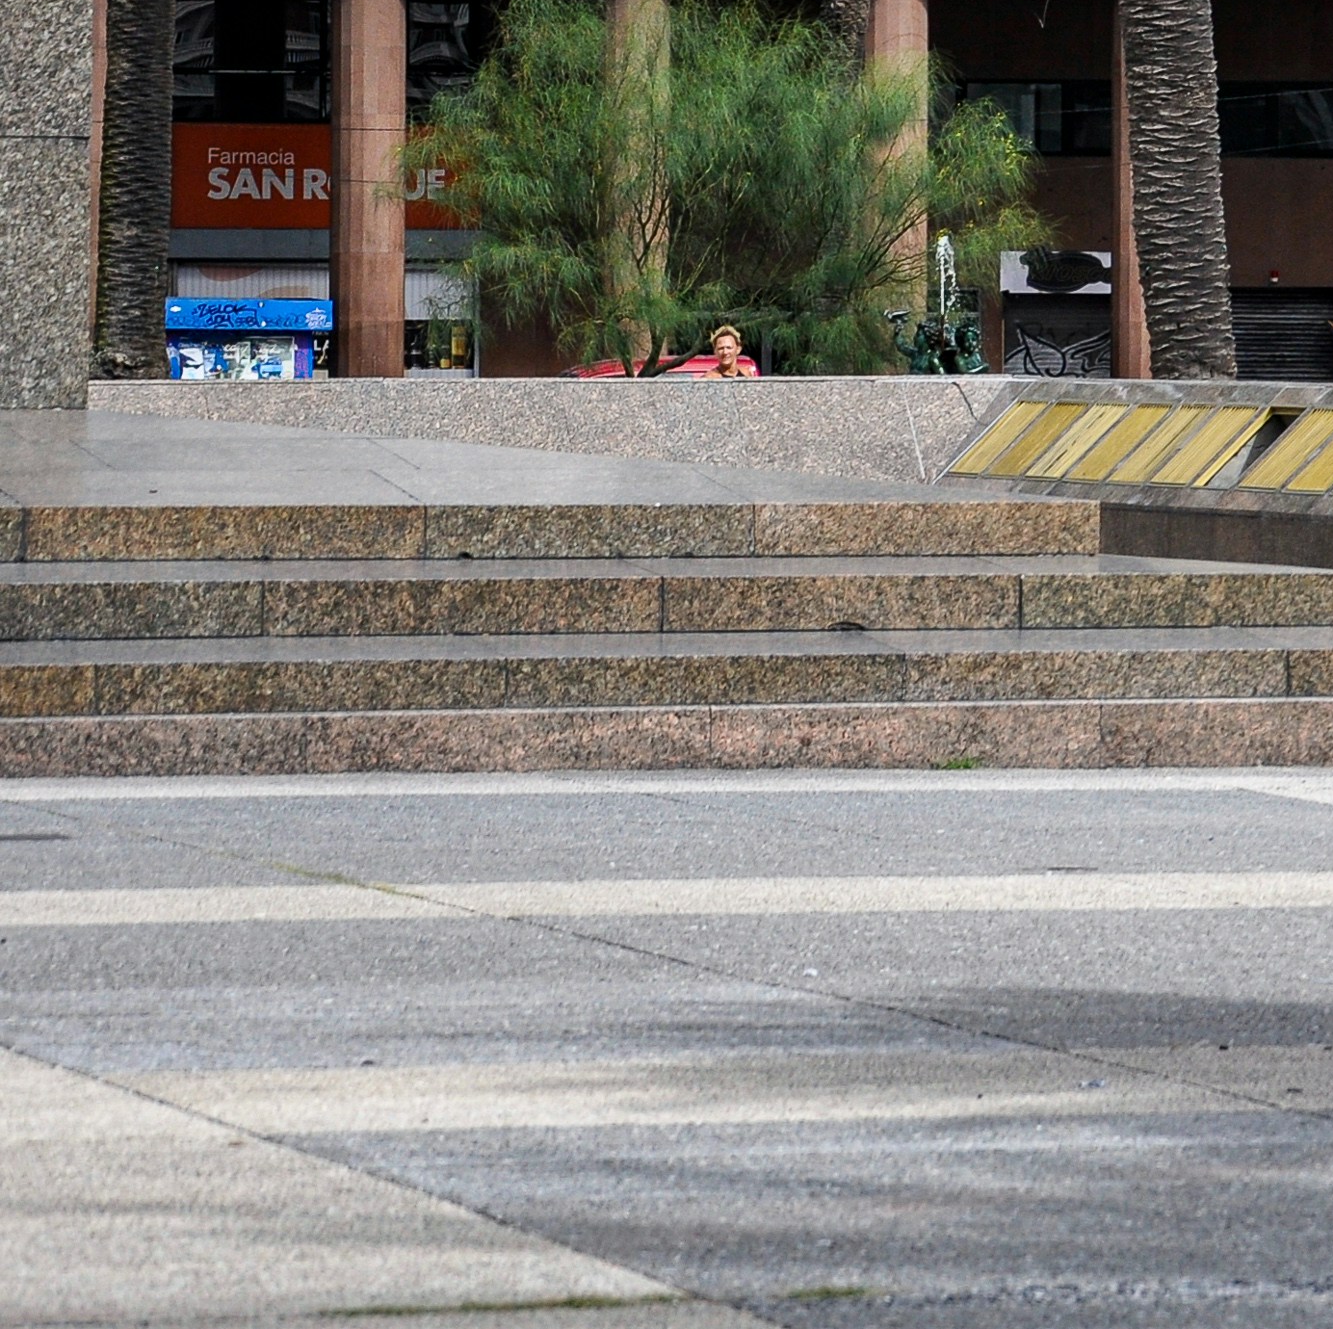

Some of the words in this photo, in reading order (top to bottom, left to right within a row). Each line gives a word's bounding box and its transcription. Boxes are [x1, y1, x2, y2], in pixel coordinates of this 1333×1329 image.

[208, 147, 295, 165] Farmacia
[207, 167, 295, 201] SAN
[302, 168, 446, 201] RUE
